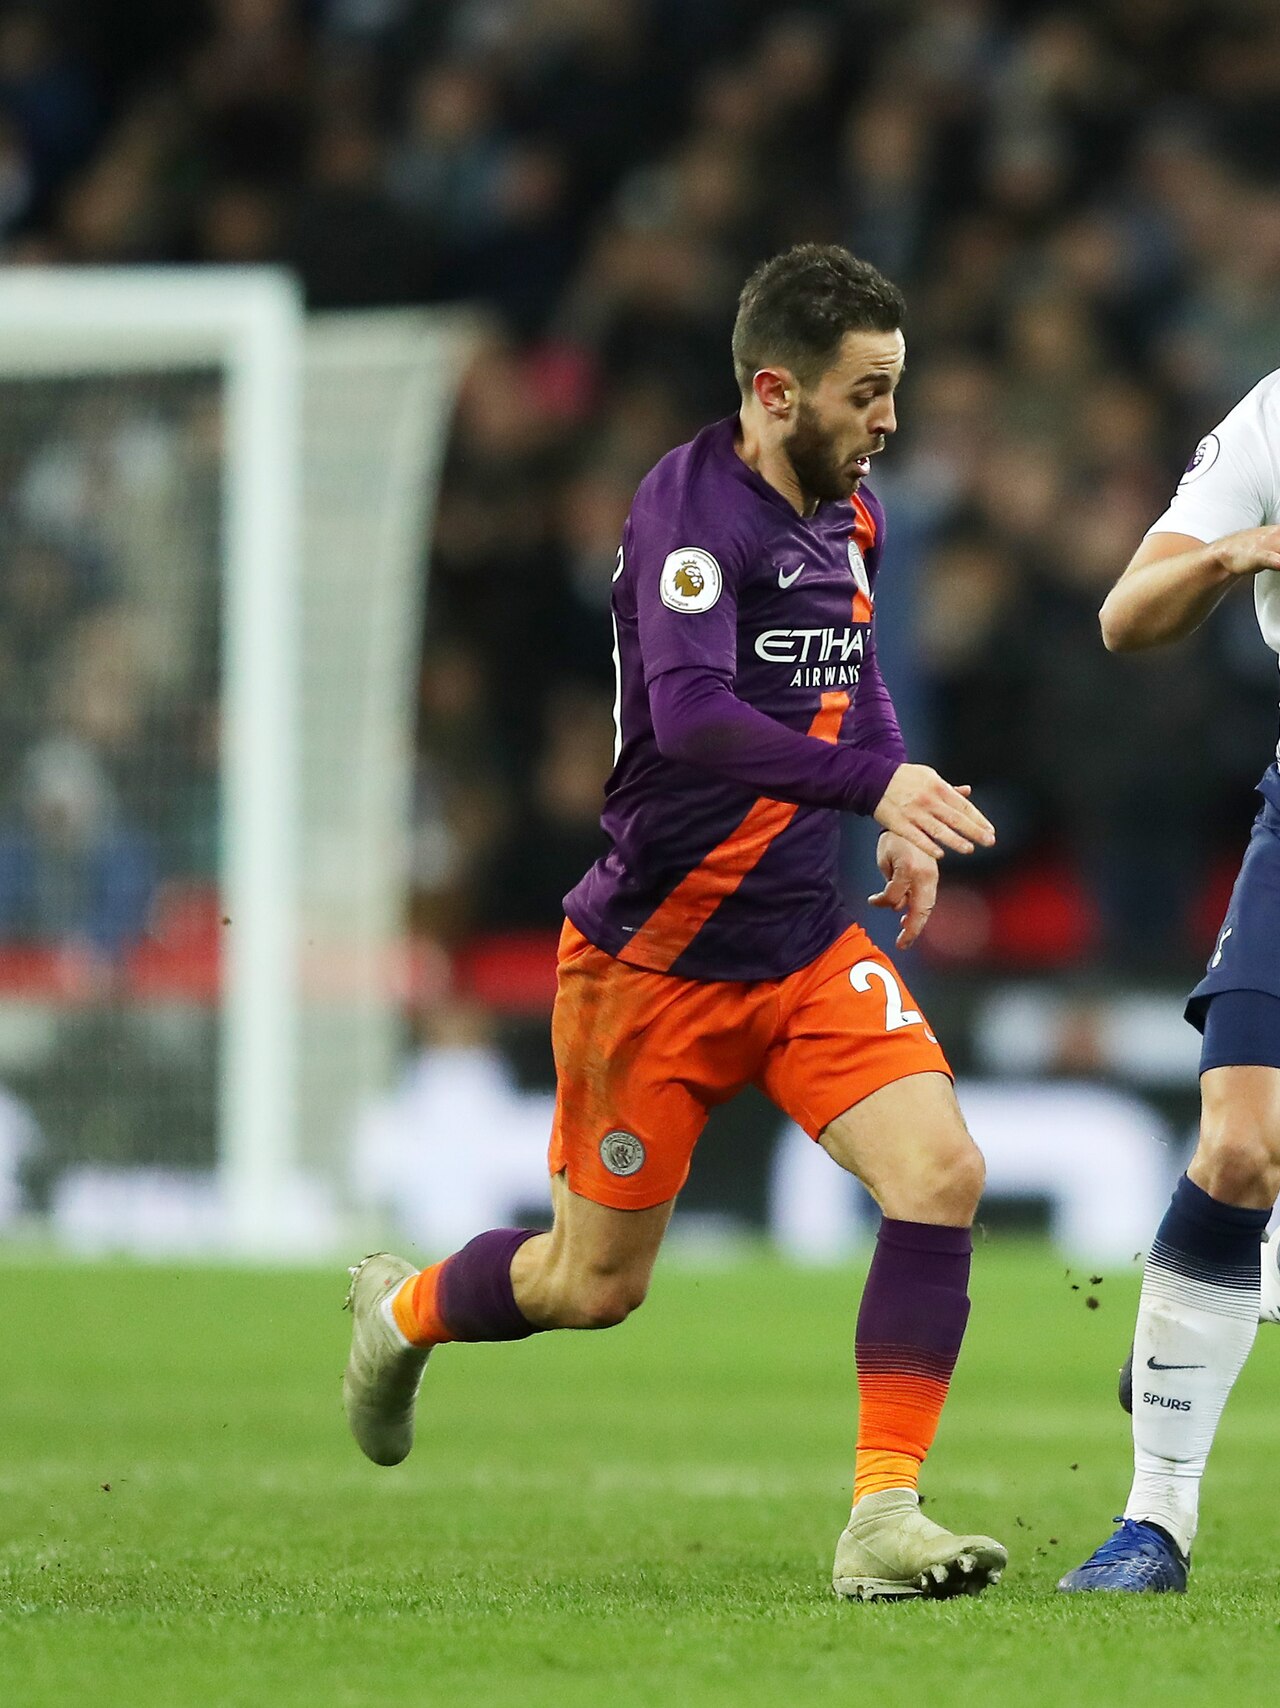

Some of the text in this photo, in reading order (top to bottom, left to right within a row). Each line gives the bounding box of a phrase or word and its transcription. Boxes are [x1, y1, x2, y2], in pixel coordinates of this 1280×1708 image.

[754, 627, 871, 663] ETIHA
[789, 664, 861, 687] AIRWAYS
[1143, 1391, 1192, 1413] SPURS
